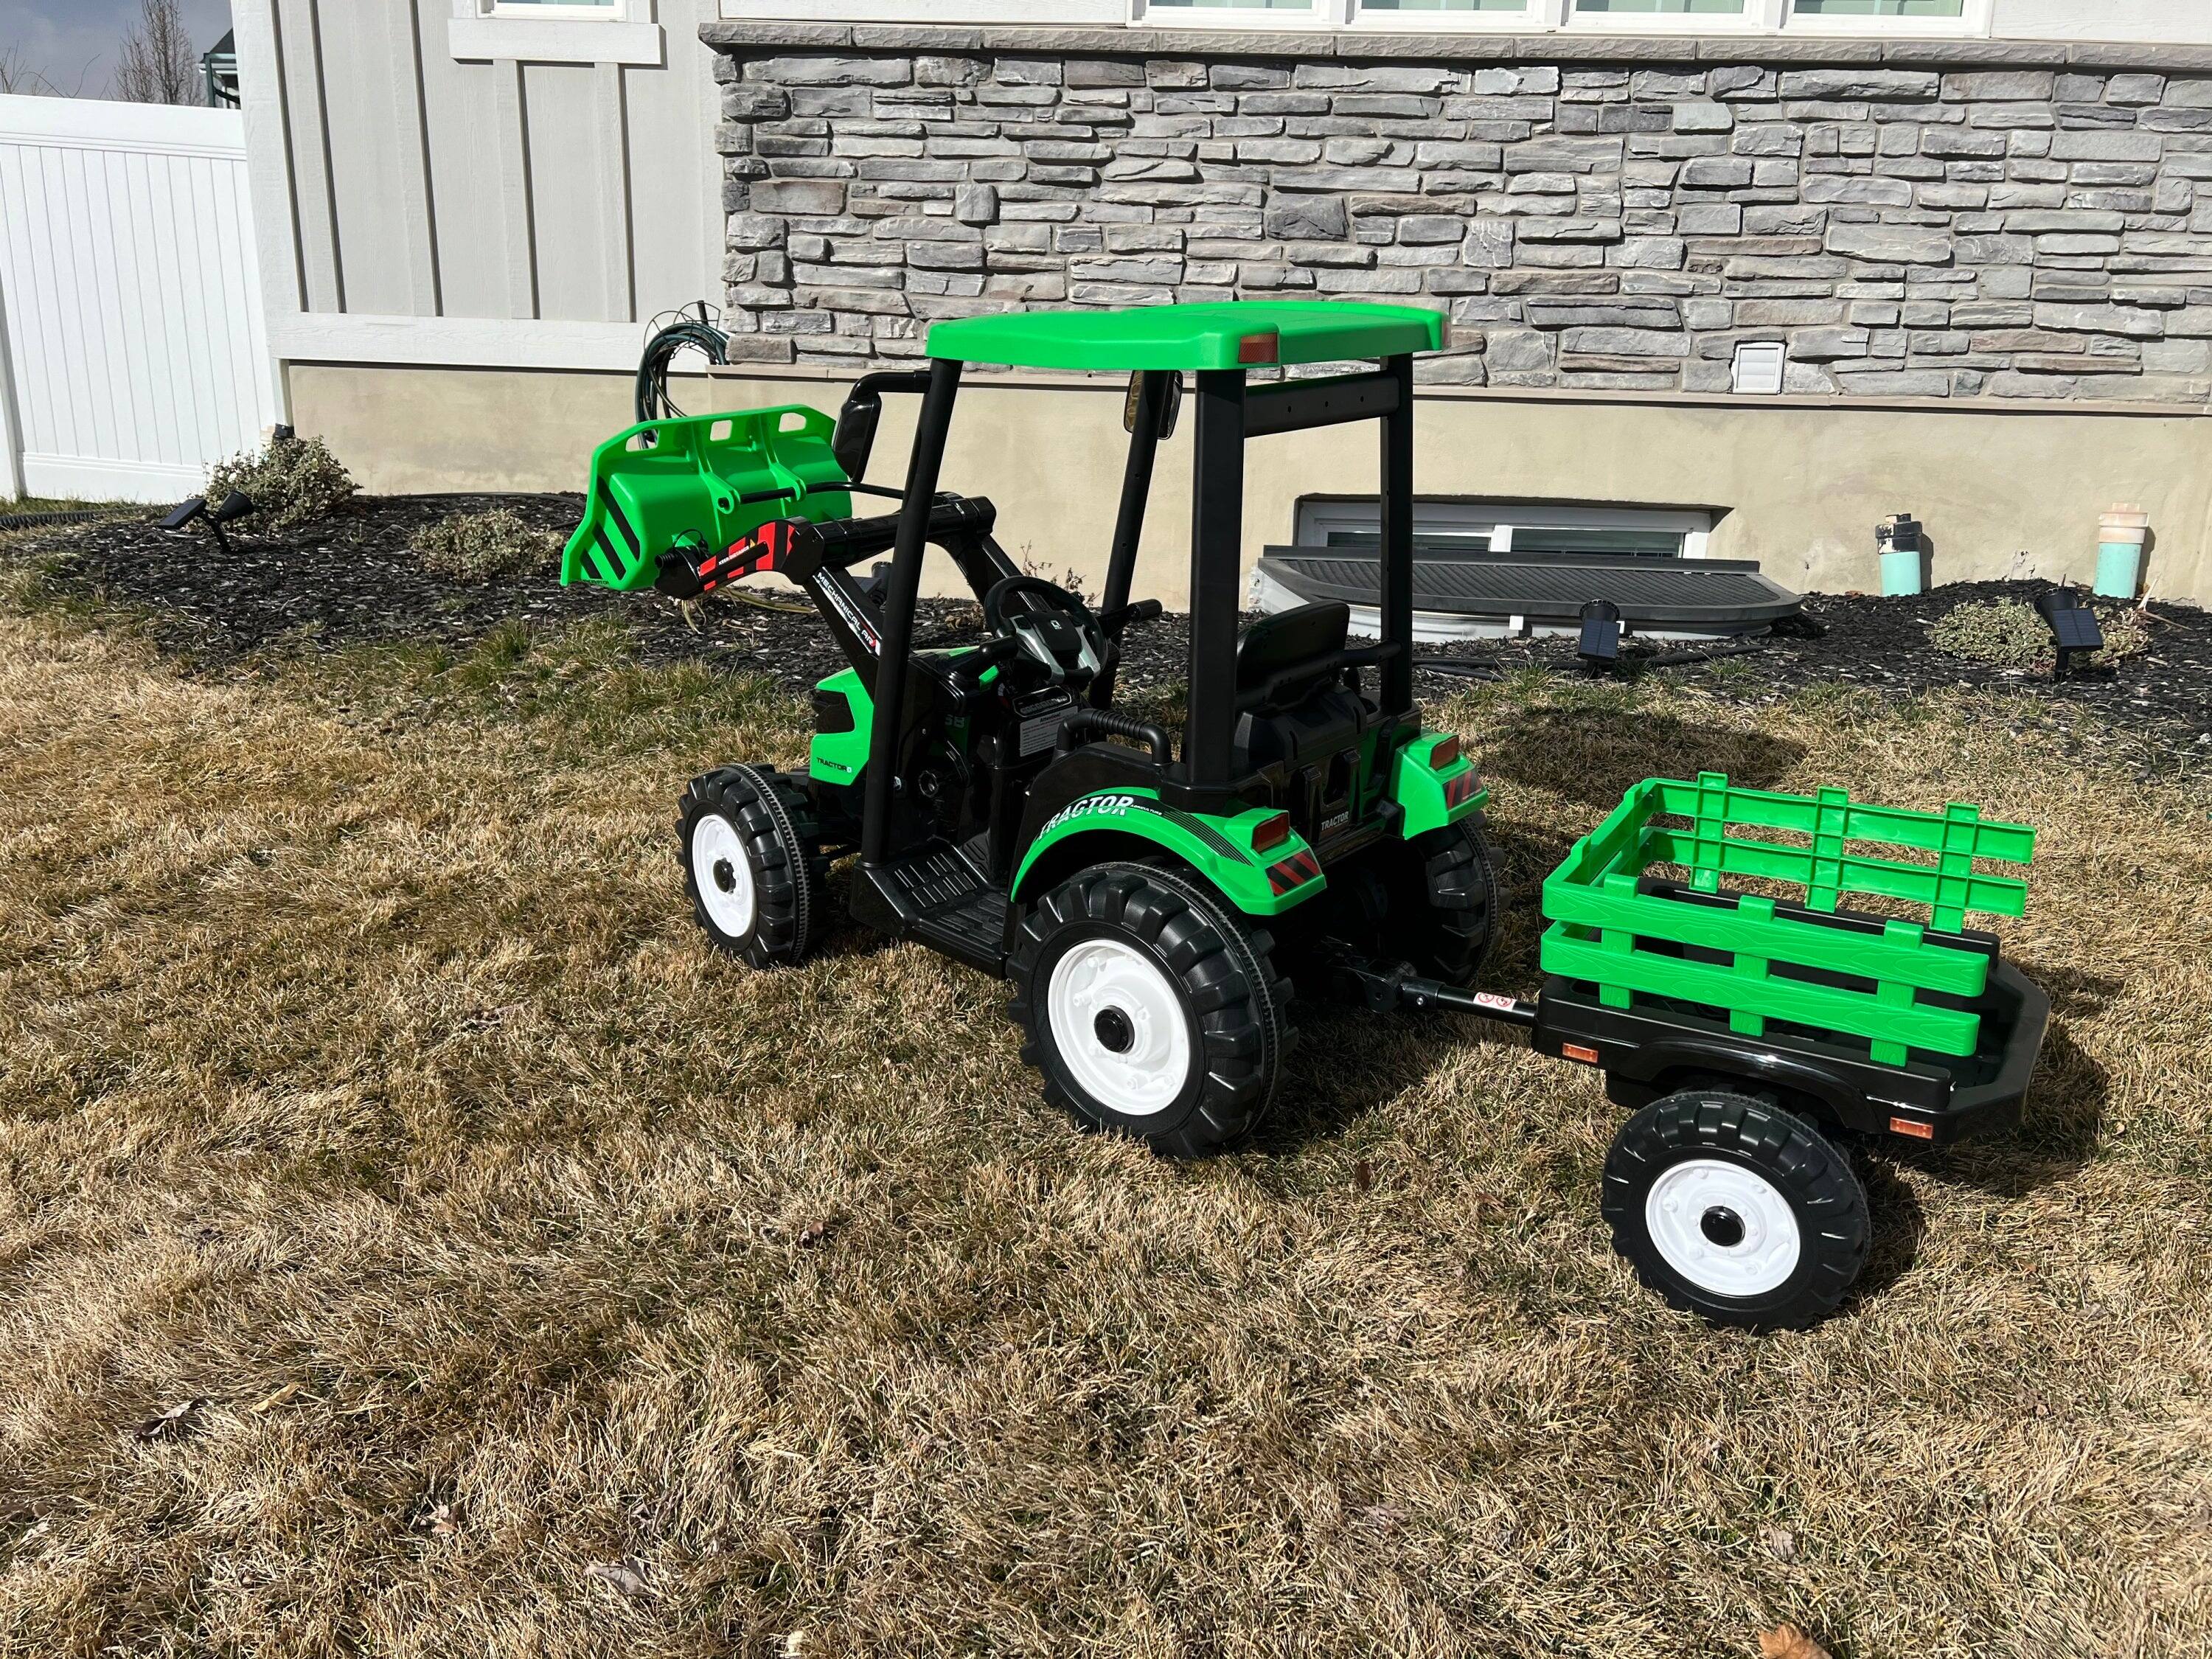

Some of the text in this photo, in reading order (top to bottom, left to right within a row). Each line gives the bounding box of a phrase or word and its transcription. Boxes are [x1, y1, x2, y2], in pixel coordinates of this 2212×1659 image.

[817, 571, 861, 631] MECHANICAL
[1037, 795, 1134, 841] TRACTOR
[1321, 810, 1349, 831] TRACTOR
